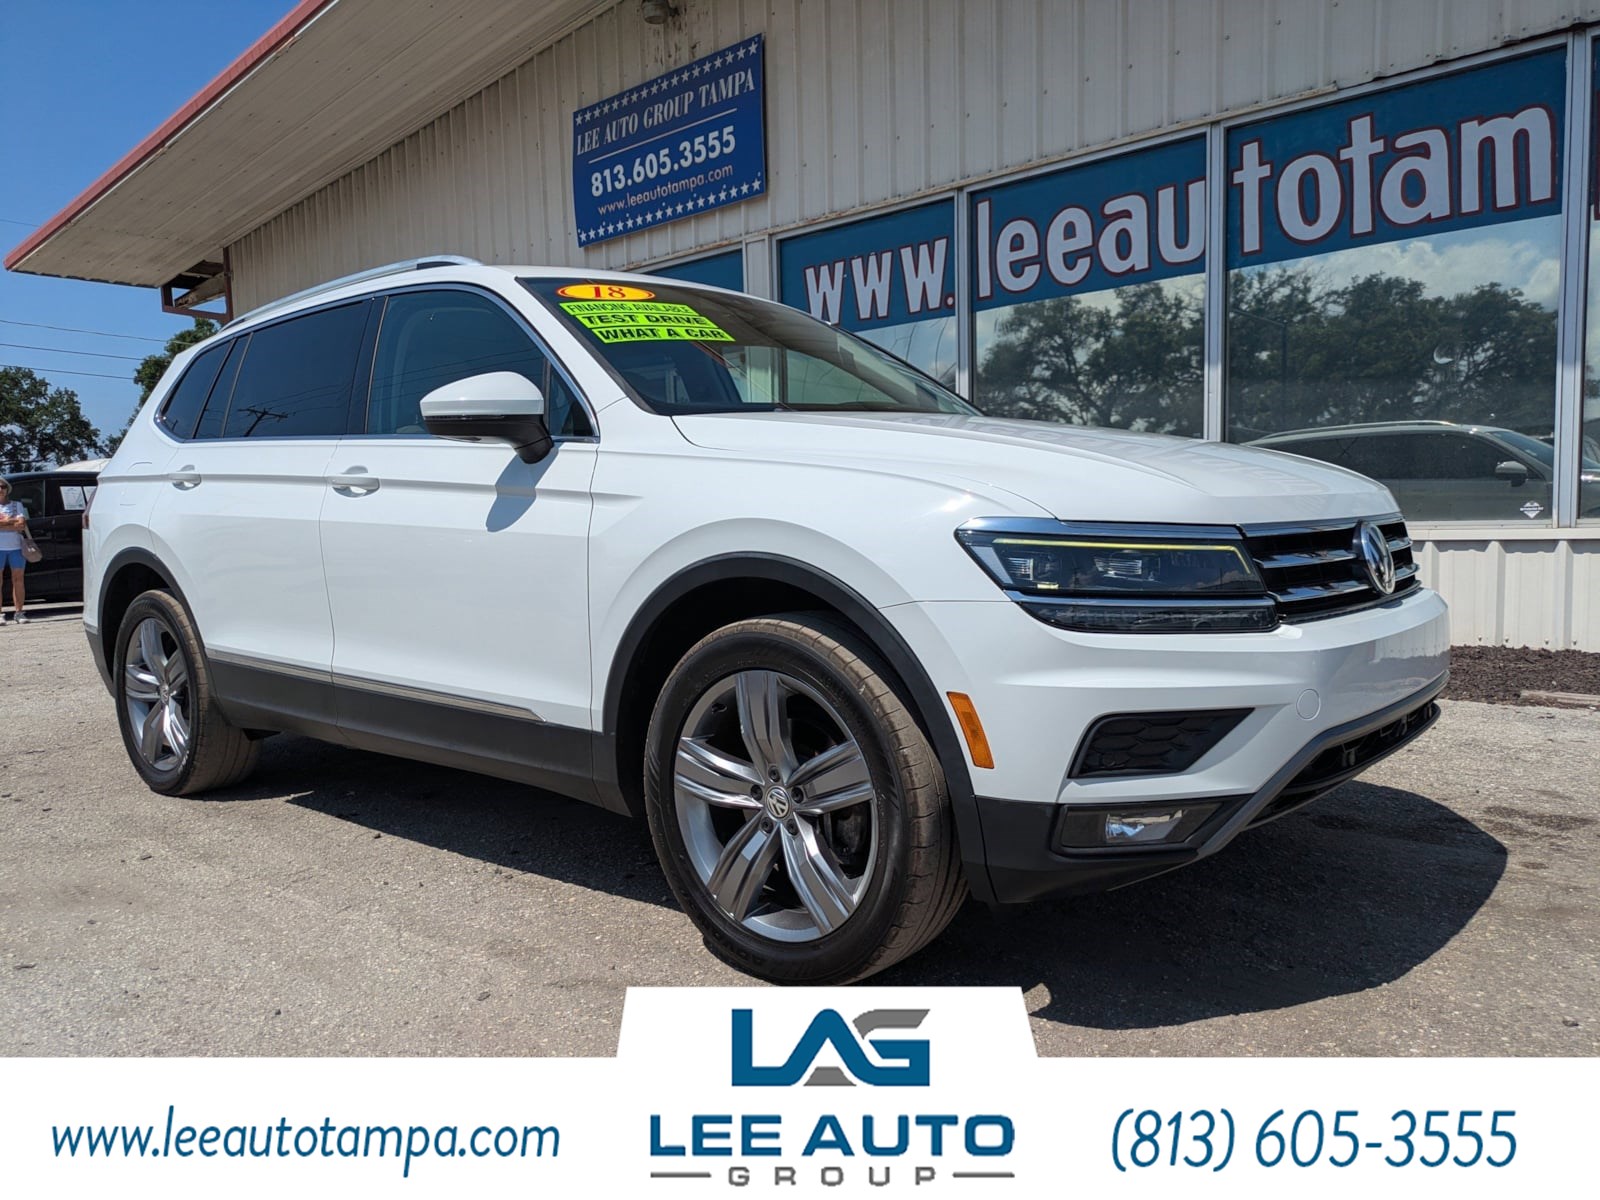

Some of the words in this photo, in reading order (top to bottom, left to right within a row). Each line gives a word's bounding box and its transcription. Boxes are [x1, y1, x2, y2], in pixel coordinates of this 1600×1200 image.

[577, 127, 600, 155] LEE
[604, 113, 639, 145] AUTO
[643, 91, 694, 129] GROUP
[699, 68, 755, 108] TAMPA
[591, 125, 736, 197] 813.605.3555
[598, 165, 733, 215] www.leeautotampa.com
[594, 286, 626, 298] 18
[567, 302, 631, 313] FINANCING
[582, 314, 638, 325] TEST
[645, 315, 707, 325] DRIVE
[600, 328, 662, 340] WHAT
[667, 328, 680, 338] A
[685, 328, 725, 339] CAR
